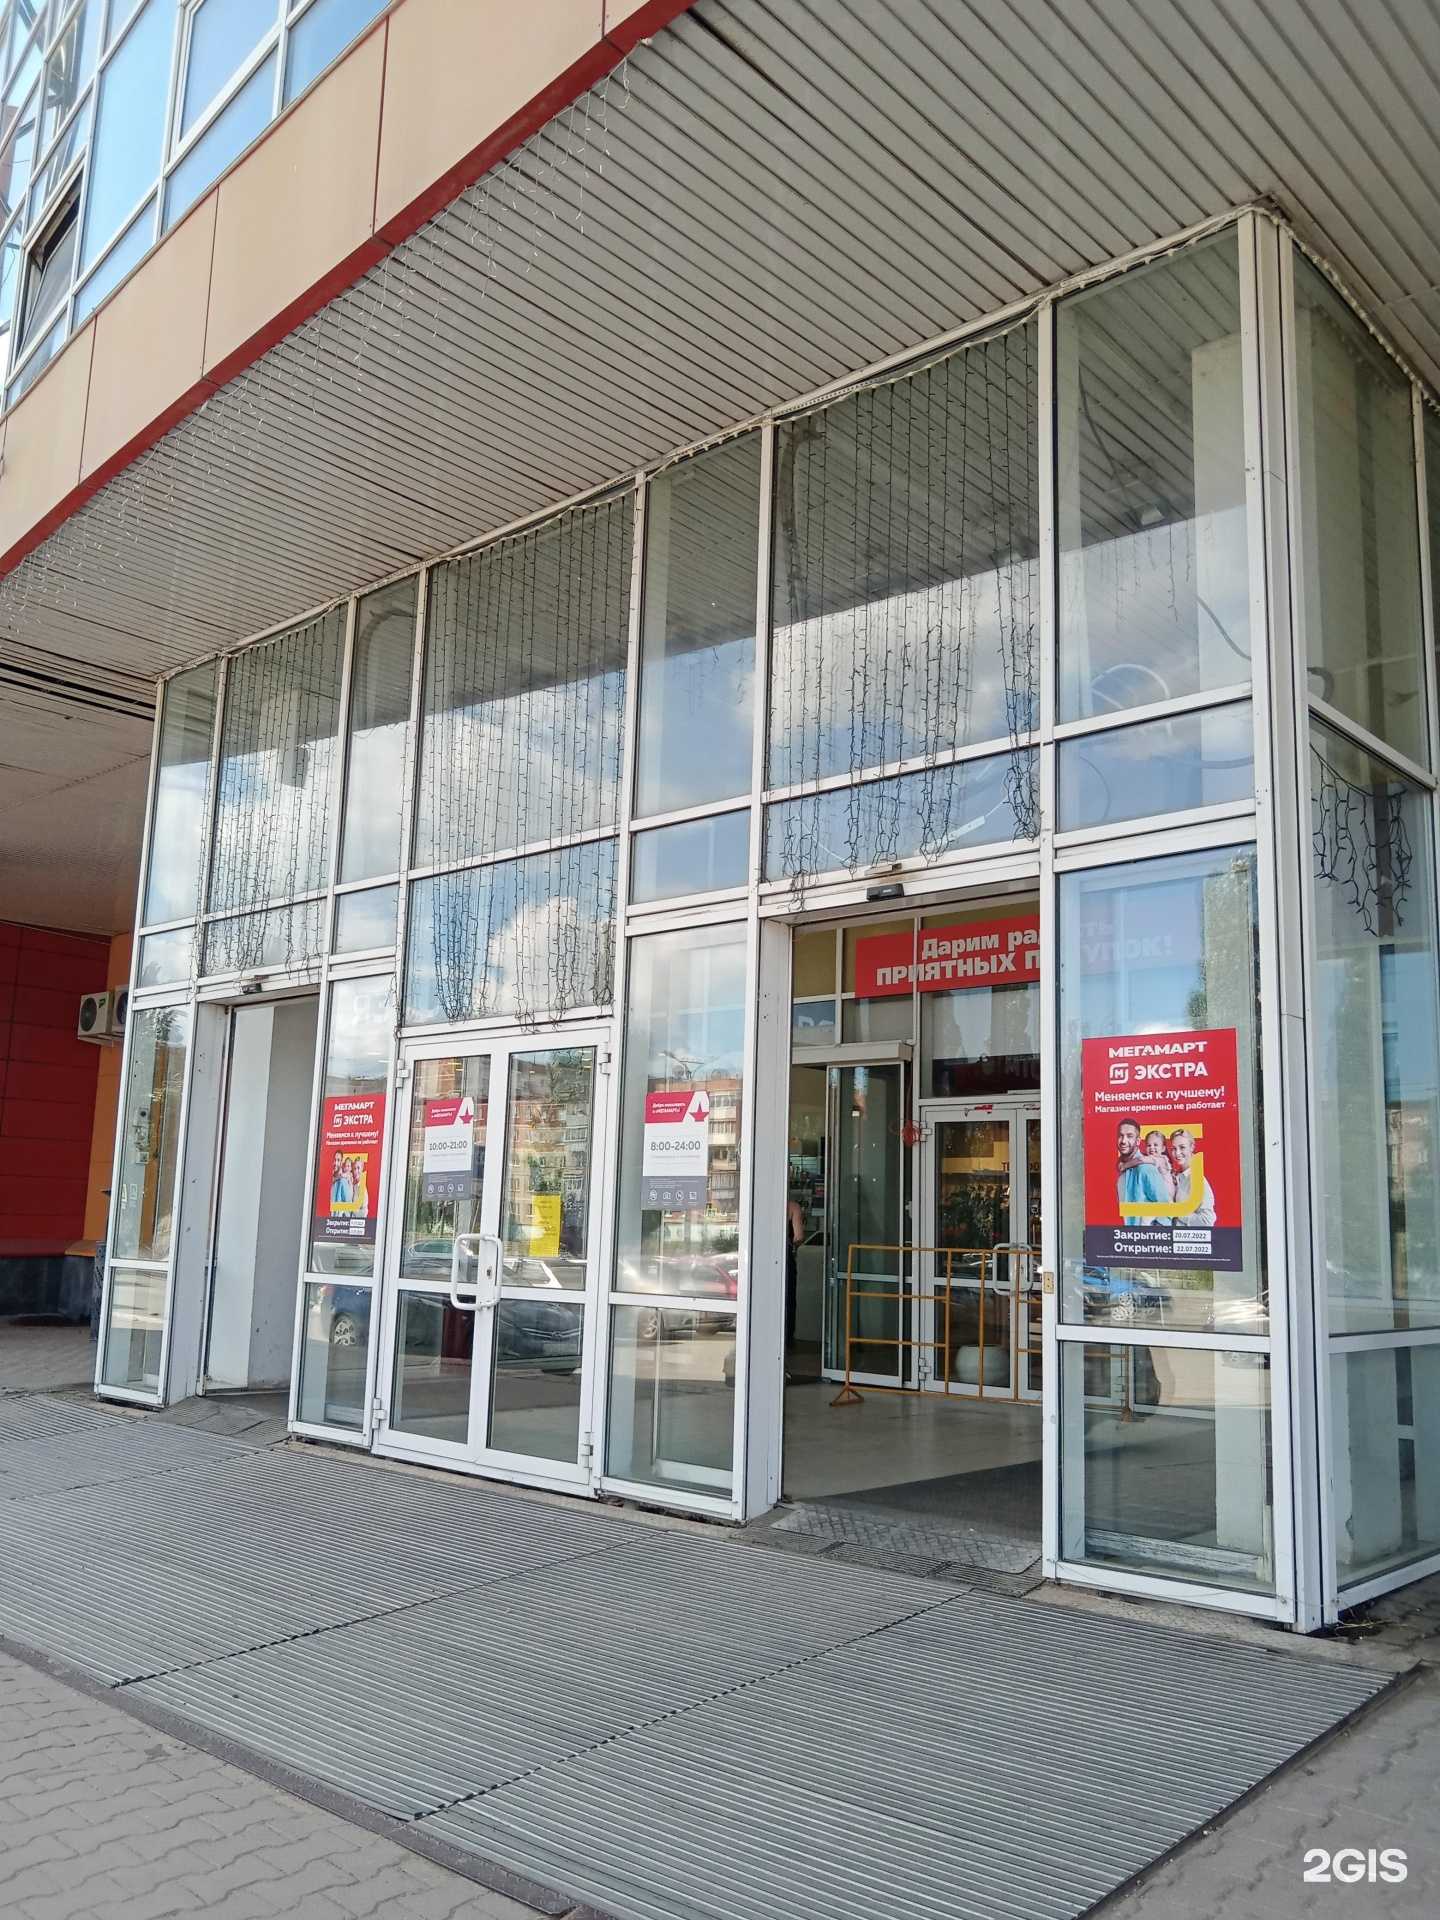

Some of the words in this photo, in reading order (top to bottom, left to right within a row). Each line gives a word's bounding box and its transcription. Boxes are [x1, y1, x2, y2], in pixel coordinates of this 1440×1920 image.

[921, 934, 999, 960] Дарим
[876, 952, 1016, 987] ПРИЯТНЫХ
[1108, 1041, 1208, 1058] МЕГАМАРТ
[1134, 1062, 1208, 1080] ЭКСТРА
[1095, 1091, 1152, 1102] Меняемся
[1155, 1091, 1163, 1100] к
[1165, 1086, 1225, 1101] лучшему!
[334, 1101, 375, 1111] МЕГАМАРТ
[1095, 1105, 1129, 1113] Магазин
[1131, 1103, 1172, 1113] временно
[1186, 1101, 1226, 1111] работает
[343, 1114, 374, 1125] ЭКСТРА
[650, 1140, 701, 1151] 8:00-24:00
[1113, 1229, 1171, 1242] Закрытие:
[1114, 1242, 1173, 1254] Открытие:
